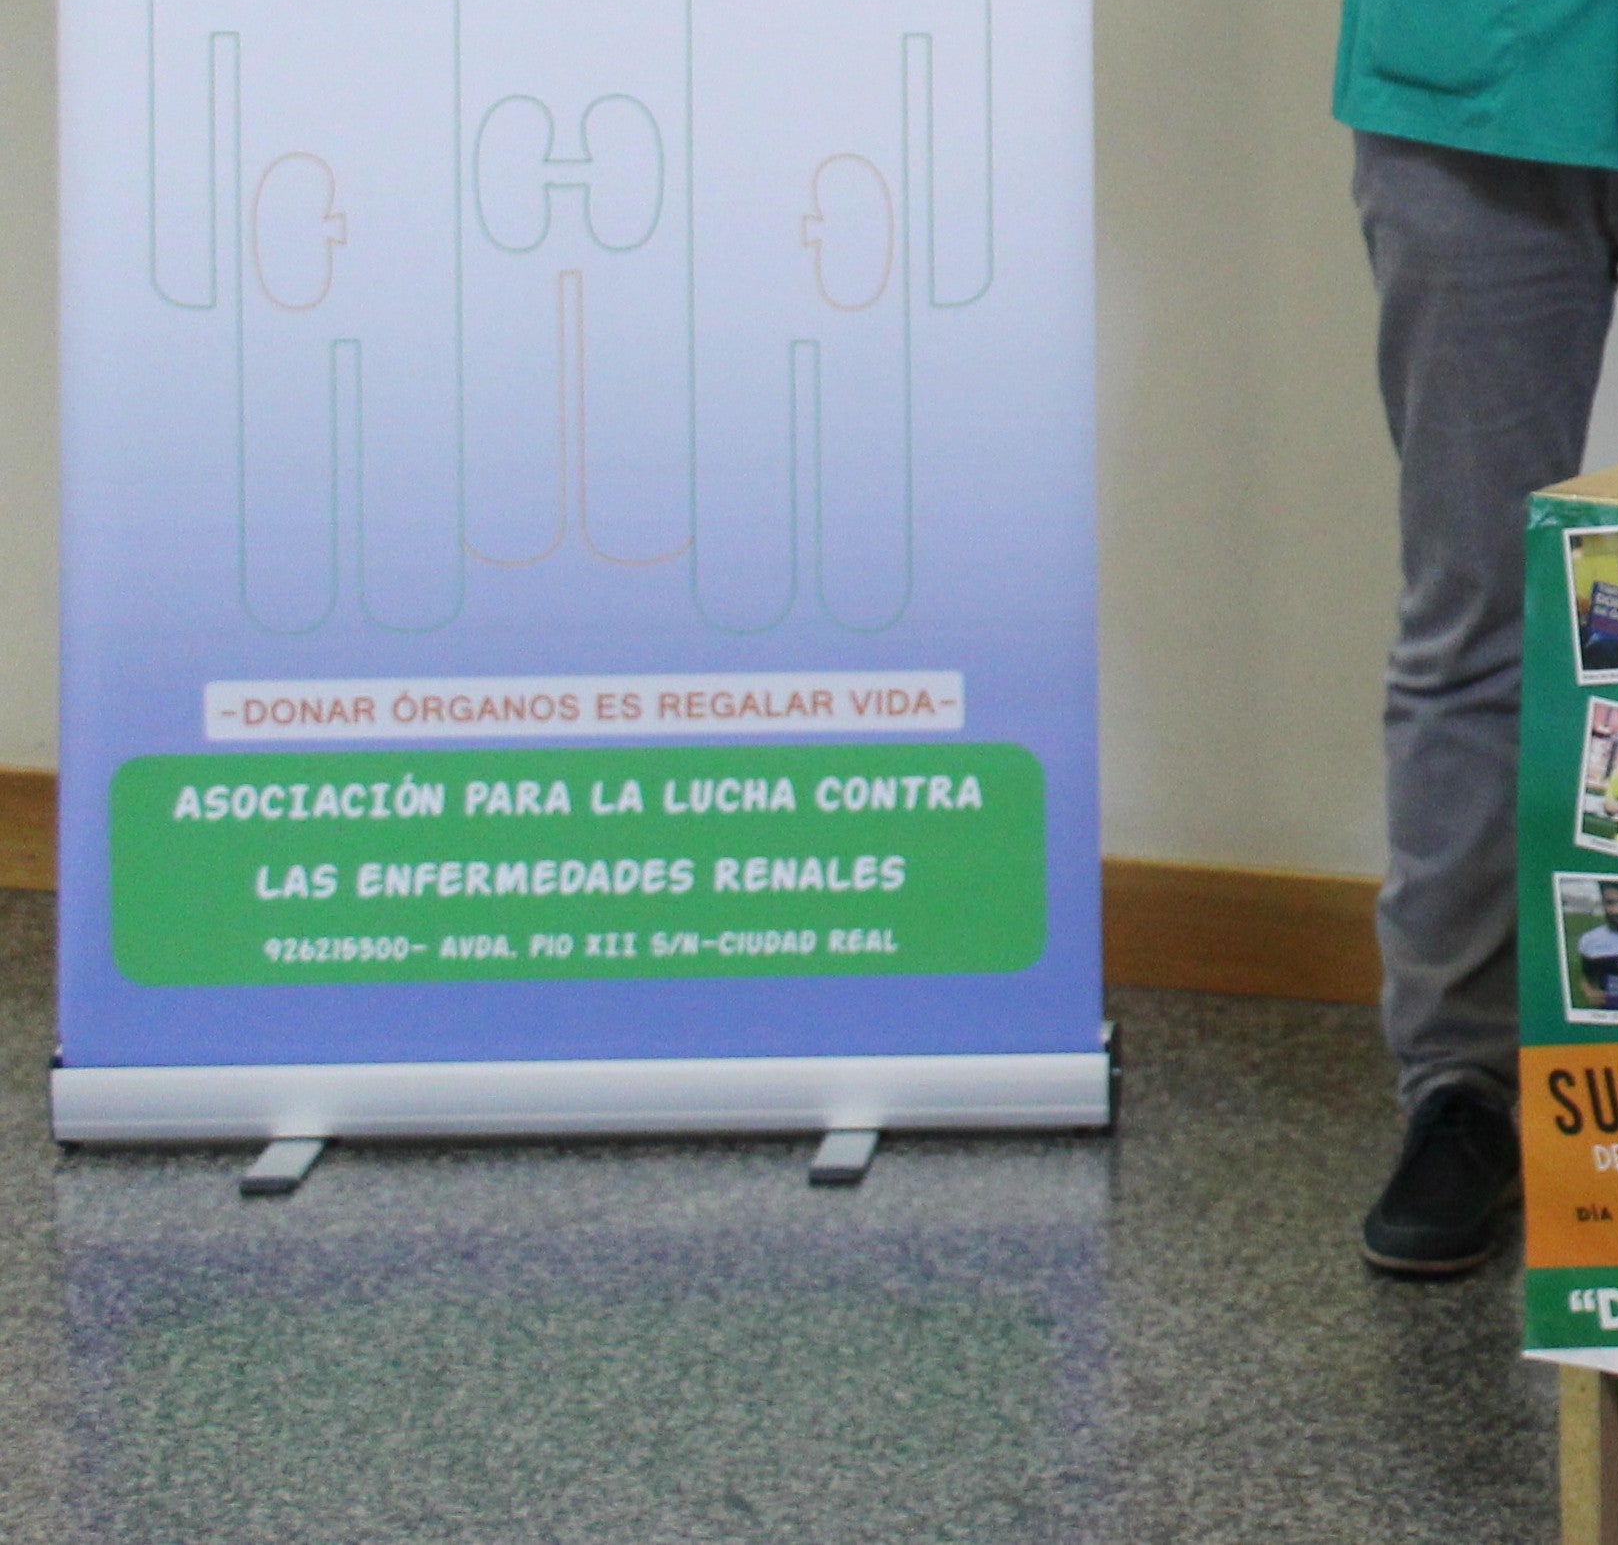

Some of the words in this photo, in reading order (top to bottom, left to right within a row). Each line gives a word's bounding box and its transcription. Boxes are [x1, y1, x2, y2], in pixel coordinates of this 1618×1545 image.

[391, 688, 582, 725] ÓRGANOS
[596, 692, 643, 723] ES
[658, 688, 836, 721] REGALAR
[173, 773, 445, 820] ASOCIACIÓN
[464, 780, 573, 817] PARA
[590, 778, 645, 815] LA
[662, 777, 797, 815] LUCHA
[815, 774, 983, 812] CONTRA
[256, 862, 338, 901] LAS
[356, 856, 696, 900] ENFERMEDADES
[713, 855, 906, 893] RENALES
[528, 934, 574, 957] PIO
[584, 932, 638, 957] XII
[828, 928, 898, 954] REAL
[1576, 1203, 1612, 1223] DÍA
